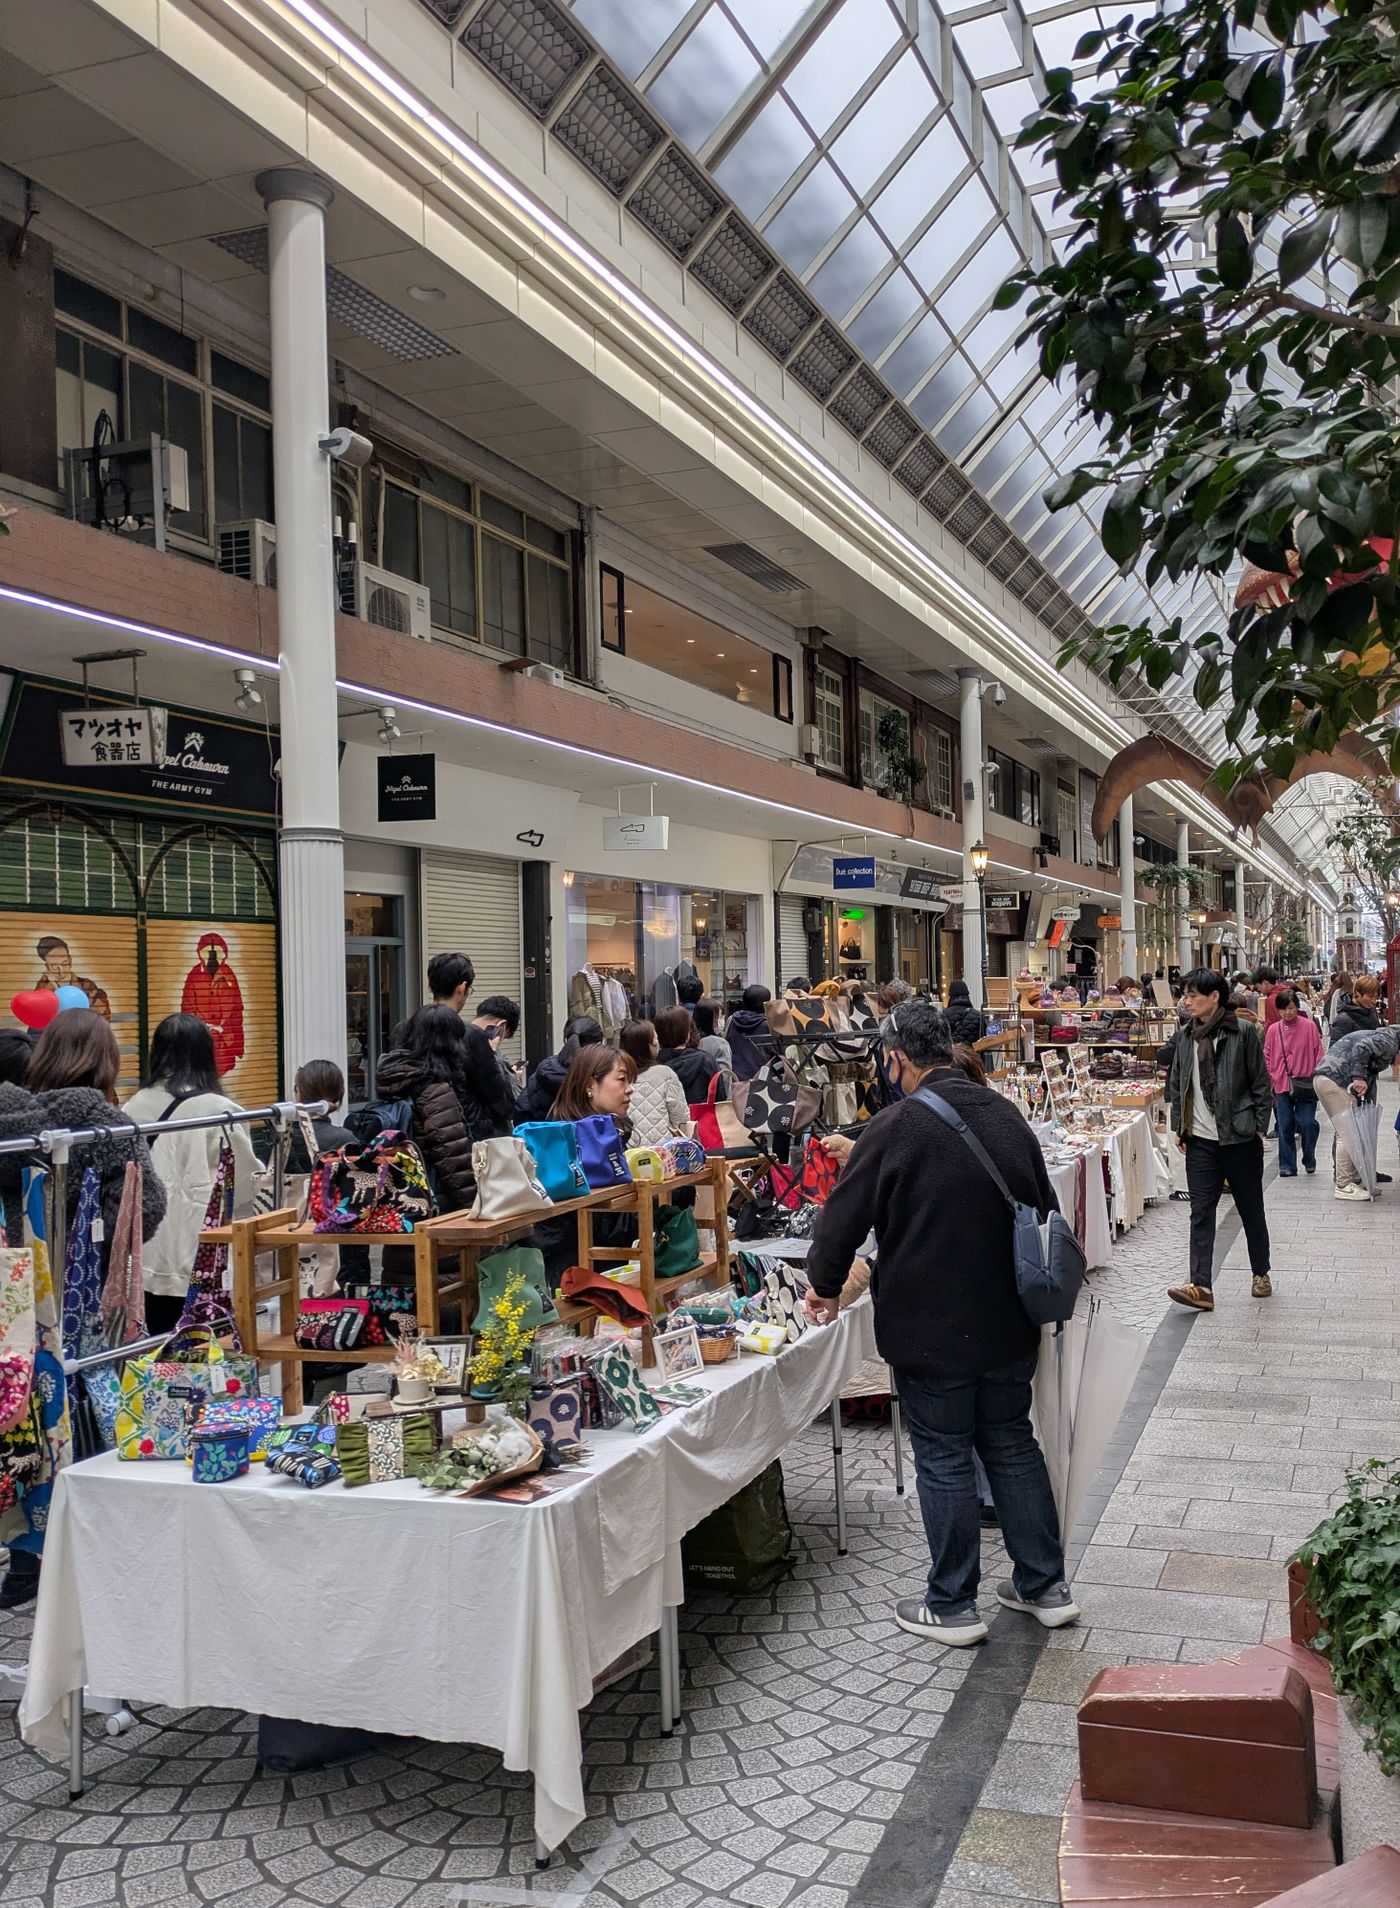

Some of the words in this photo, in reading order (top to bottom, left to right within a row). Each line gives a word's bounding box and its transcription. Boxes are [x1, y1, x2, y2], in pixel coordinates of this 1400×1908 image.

[68, 717, 142, 738] マツオヤ
[91, 741, 142, 762] 食器店
[181, 753, 230, 775] Cabourn
[151, 779, 168, 790] THE
[169, 783, 192, 793] ARMY
[194, 786, 213, 796] GYM
